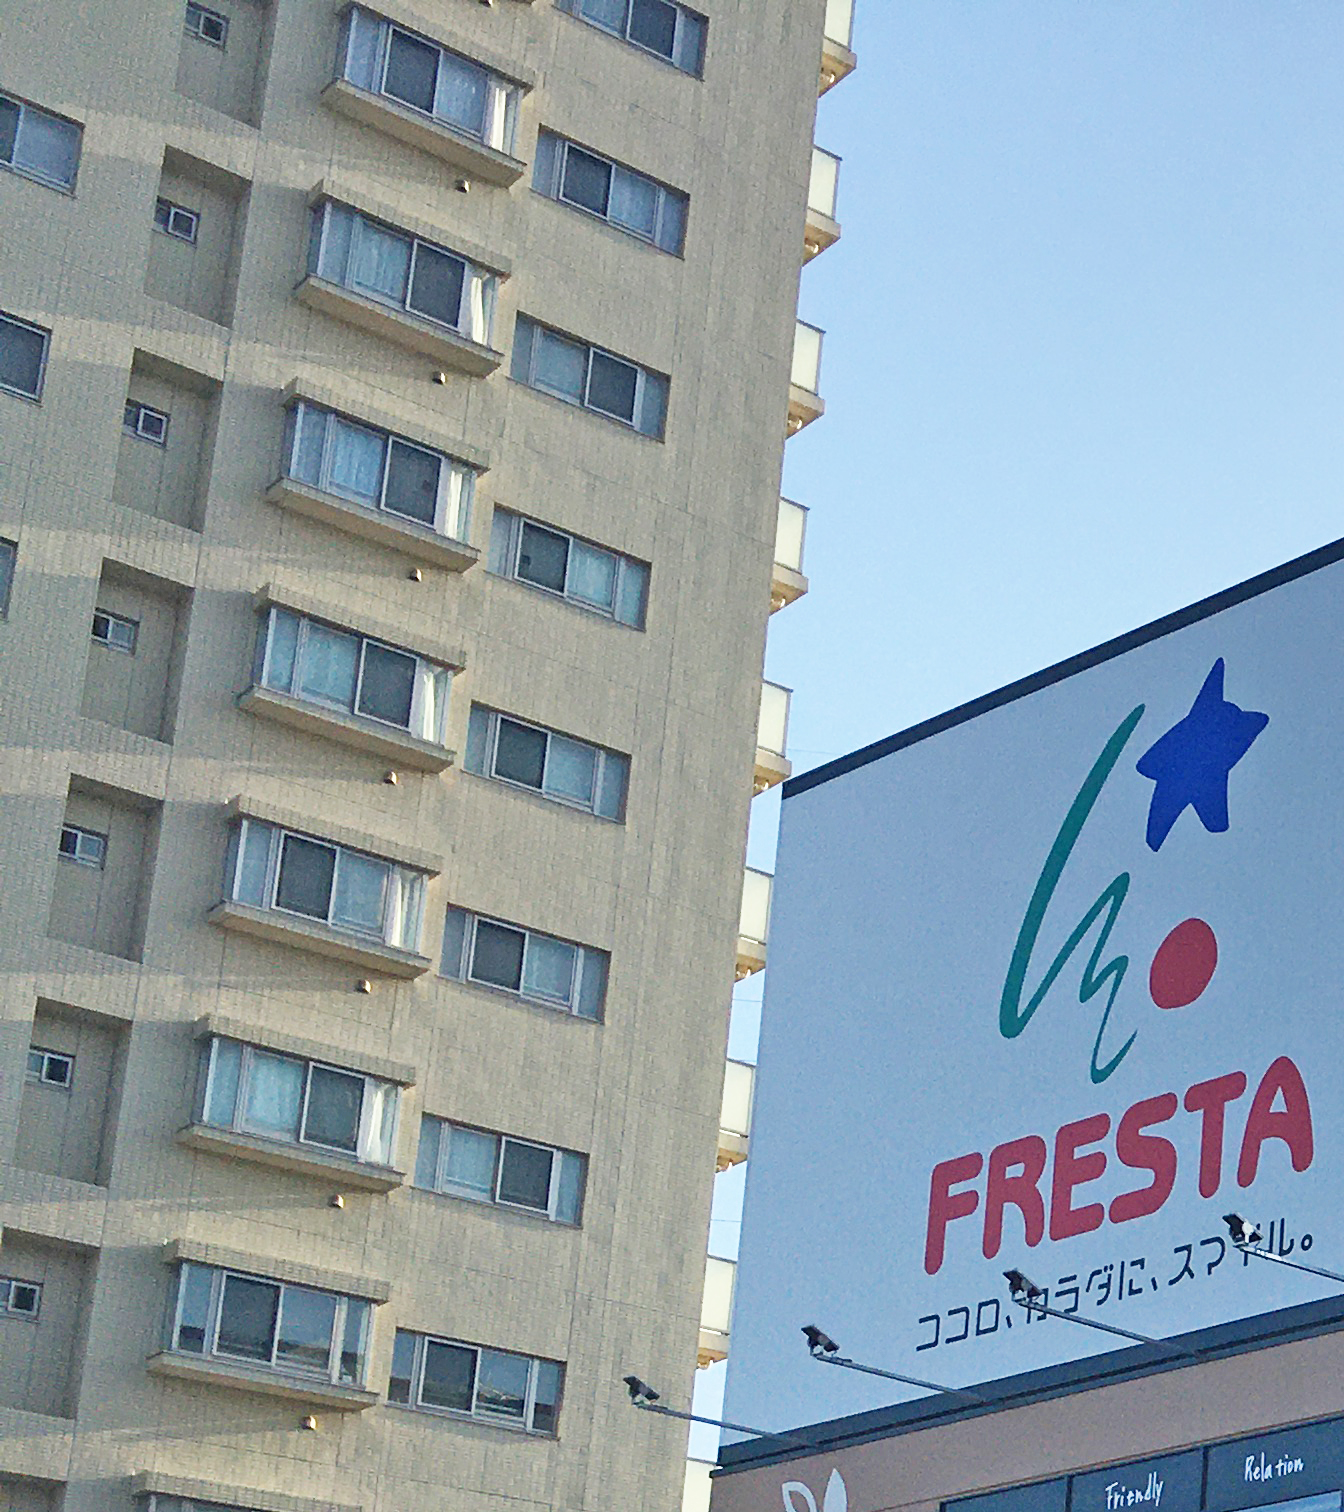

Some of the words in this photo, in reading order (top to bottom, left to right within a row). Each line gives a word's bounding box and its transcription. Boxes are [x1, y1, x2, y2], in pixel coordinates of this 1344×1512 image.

[924, 1056, 1315, 1275] FRESTA
[1244, 1453, 1306, 1483] Relation
[1104, 1471, 1165, 1510] Friendly
